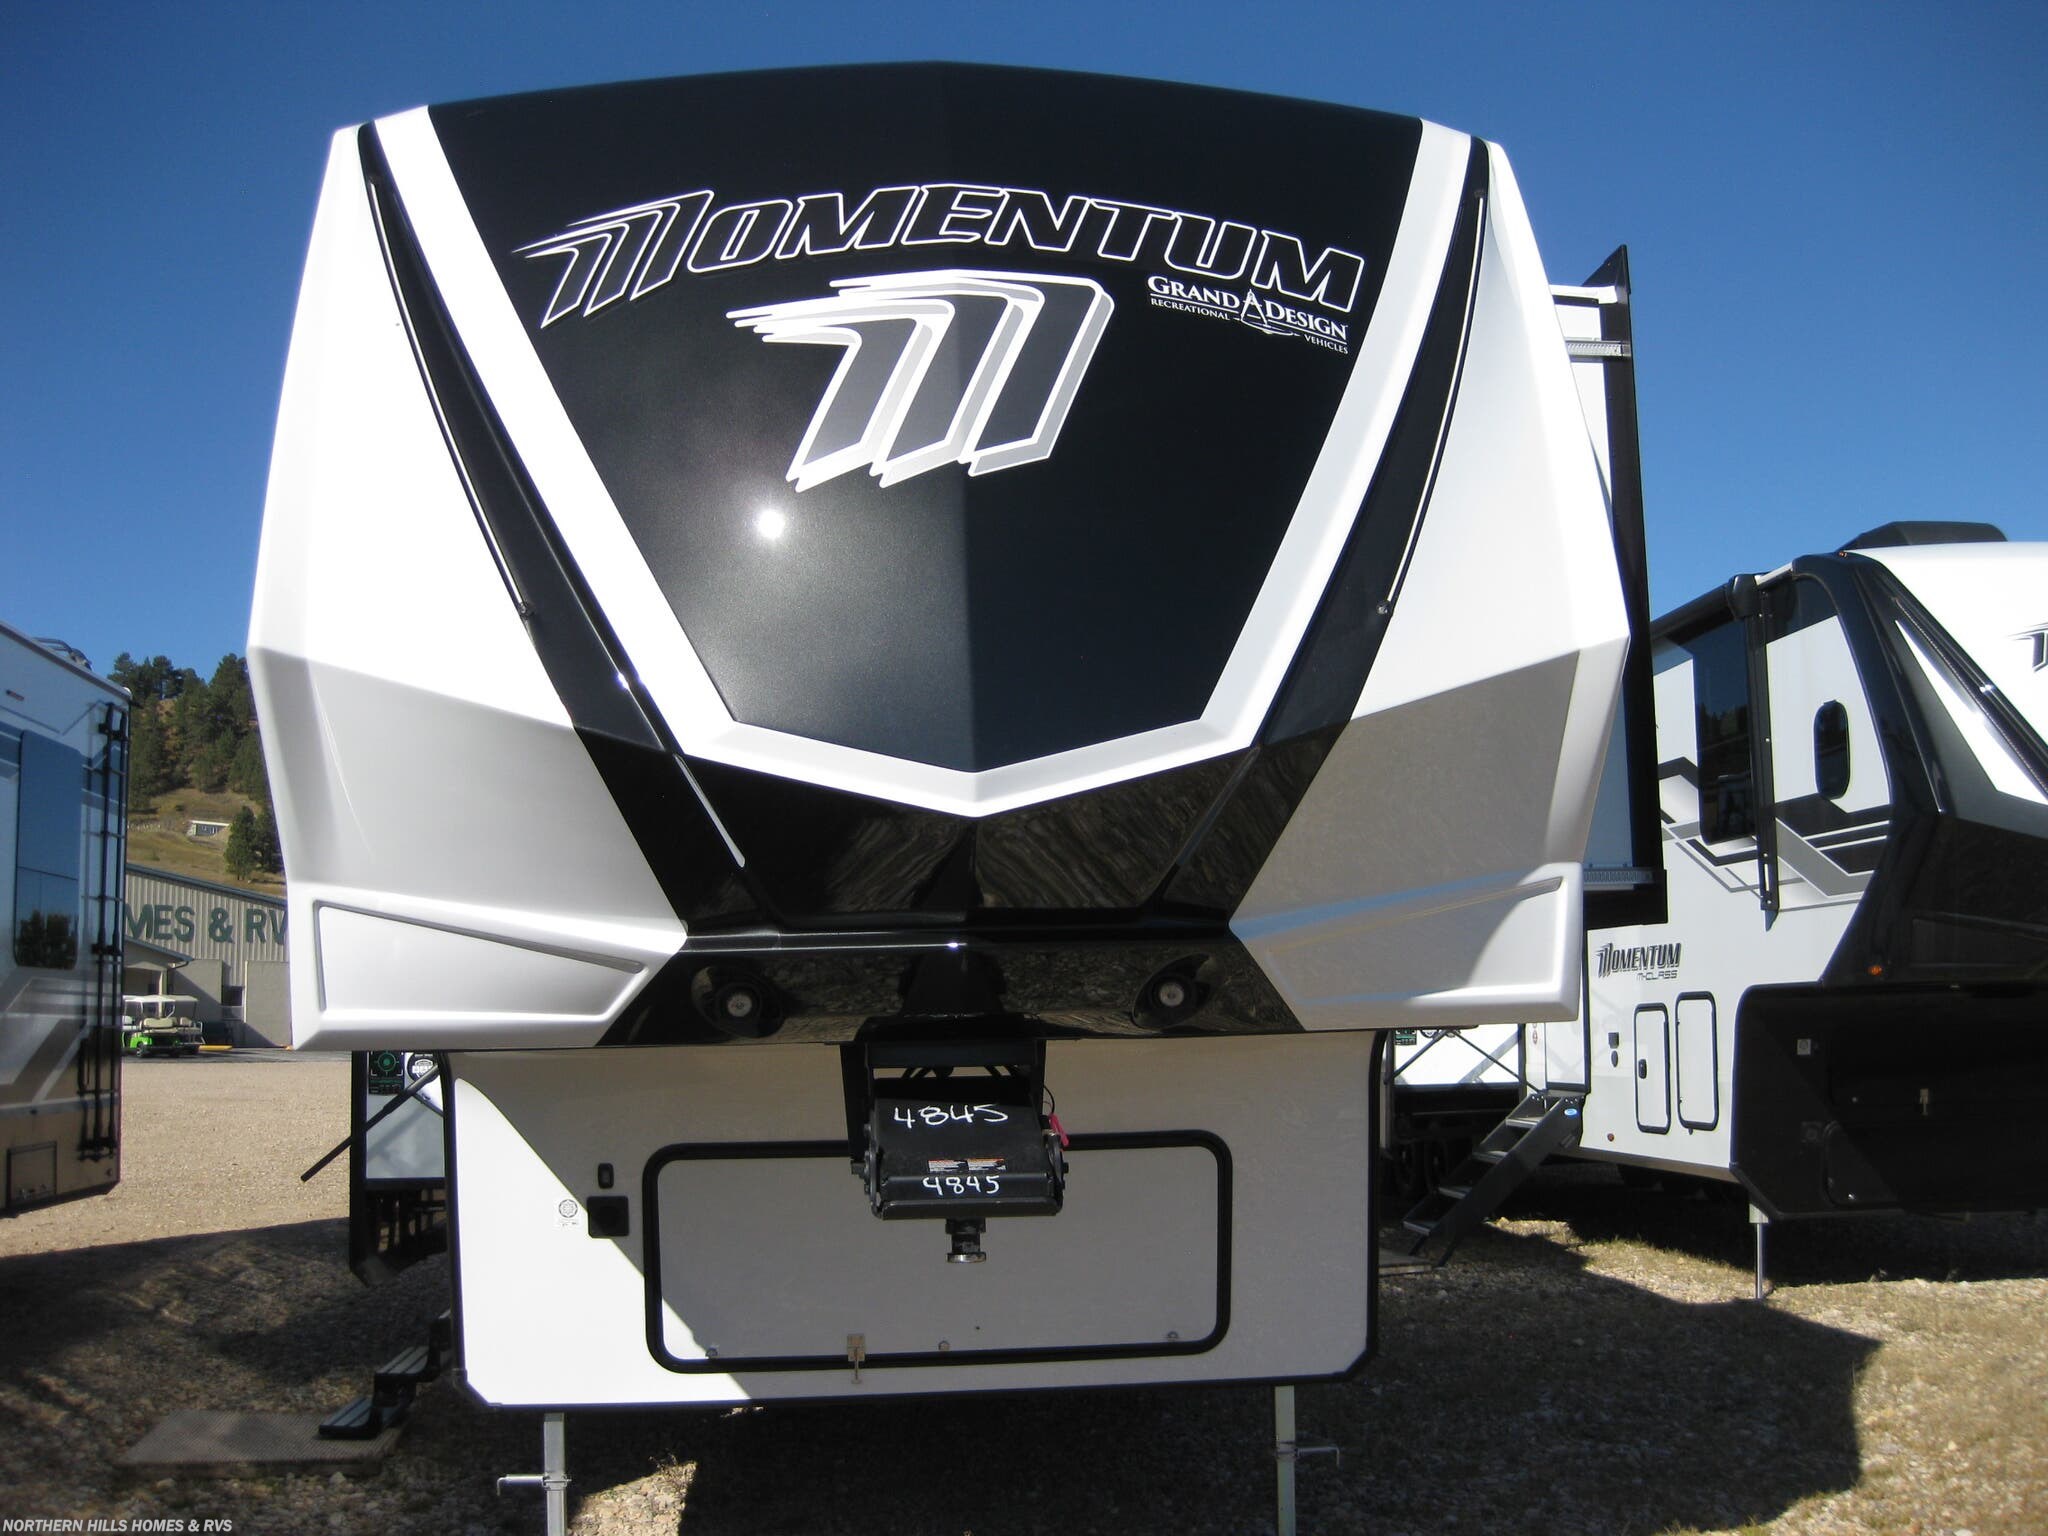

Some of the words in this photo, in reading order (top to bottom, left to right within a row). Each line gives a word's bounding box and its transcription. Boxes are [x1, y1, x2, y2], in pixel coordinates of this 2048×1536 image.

[514, 182, 1367, 328] MOMENTUM
[1147, 275, 1240, 309] GRAND
[1264, 299, 1347, 341] DESIGN
[1150, 297, 1231, 321] RECREATIONAL
[1304, 333, 1349, 354] VEHICLES
[208, 907, 235, 945] &
[1595, 942, 1682, 978] MOMENTUM
[893, 1103, 1009, 1129] 4845
[922, 1175, 1000, 1196] 4845
